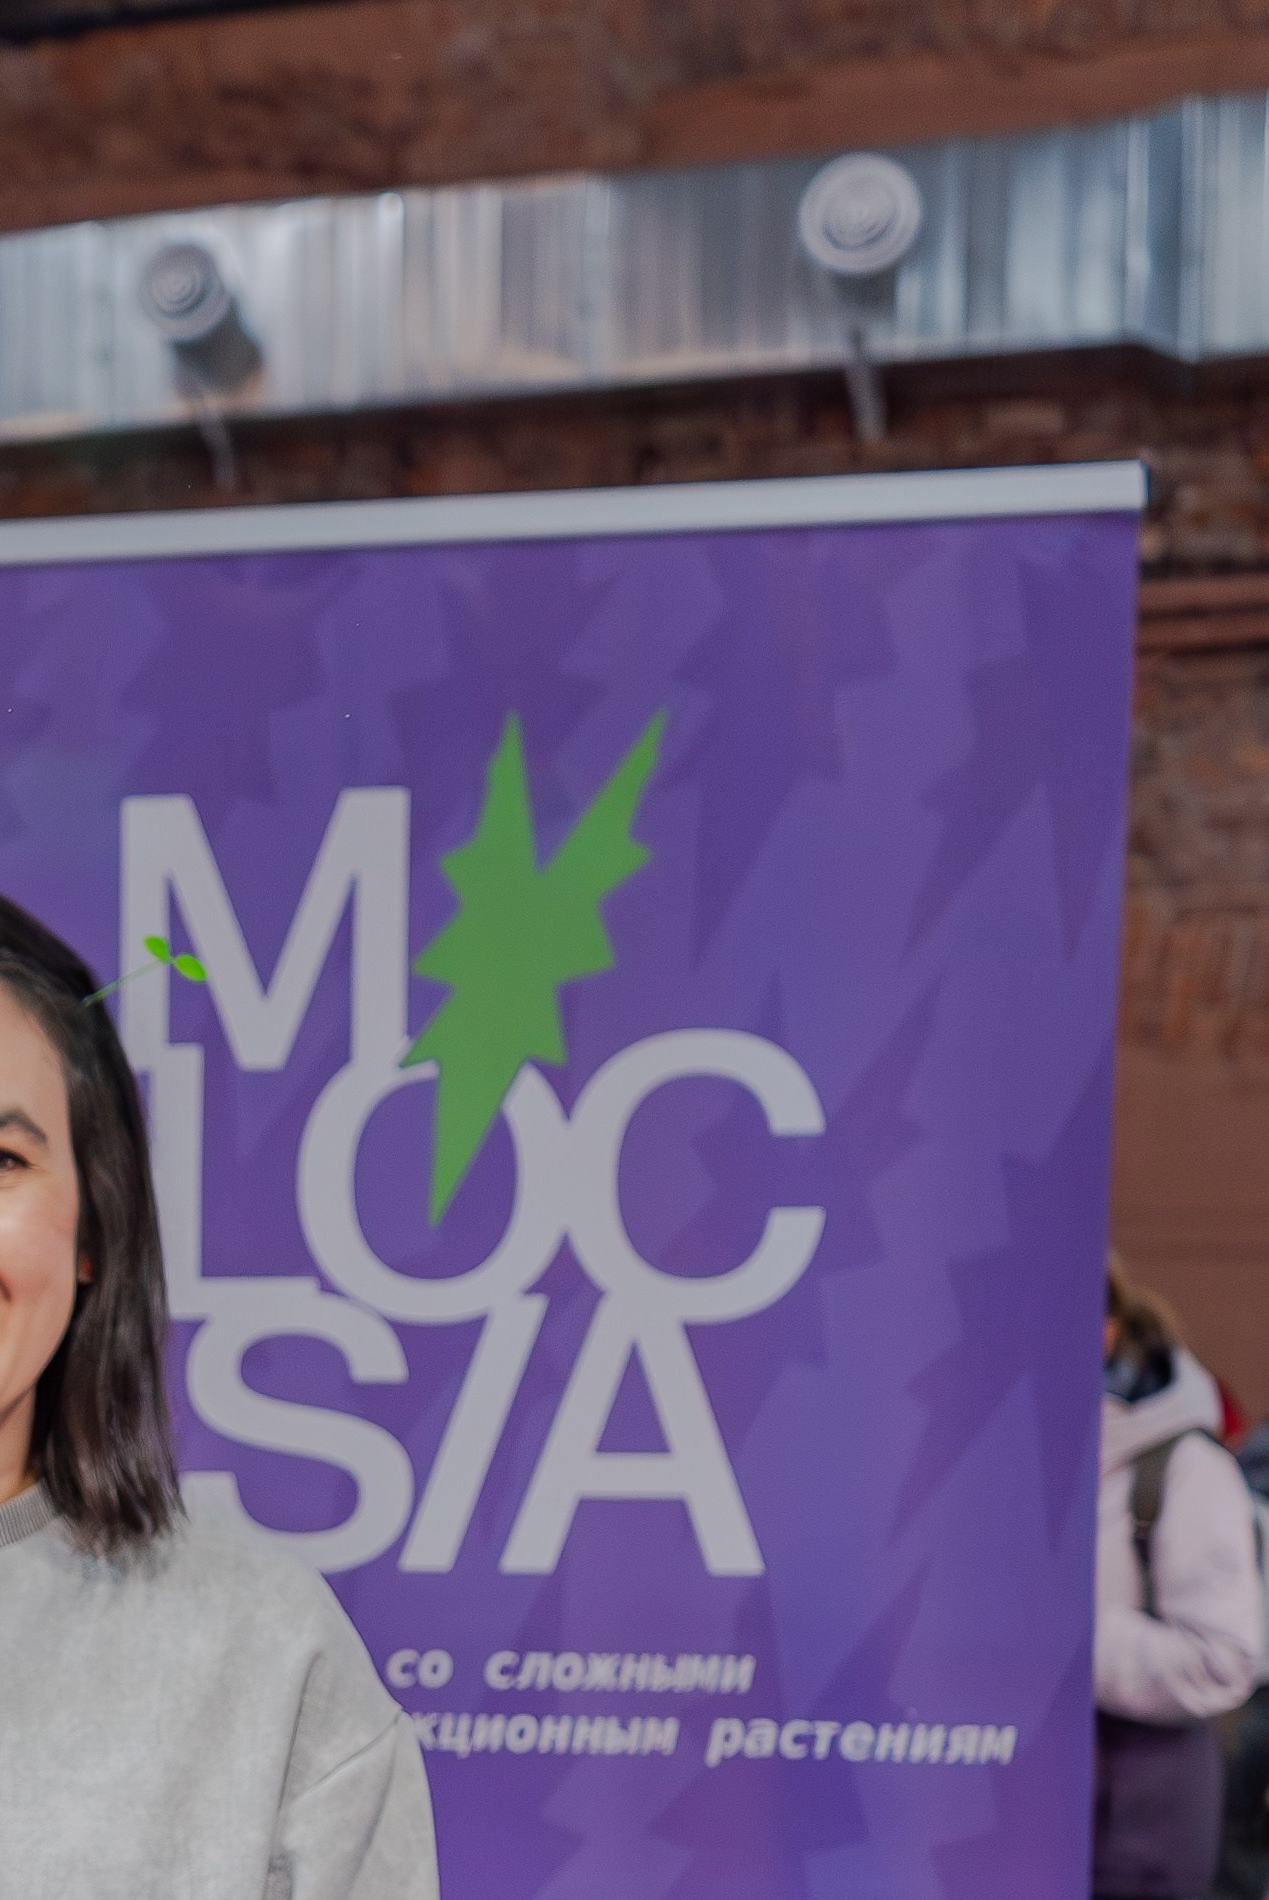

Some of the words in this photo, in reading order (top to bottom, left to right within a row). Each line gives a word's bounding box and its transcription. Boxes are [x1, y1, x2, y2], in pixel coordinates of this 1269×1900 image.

[386, 1648, 454, 1690] со
[483, 1650, 757, 1695] сложными
[412, 1711, 681, 1759] кционным
[705, 1715, 1018, 1767] растениям
